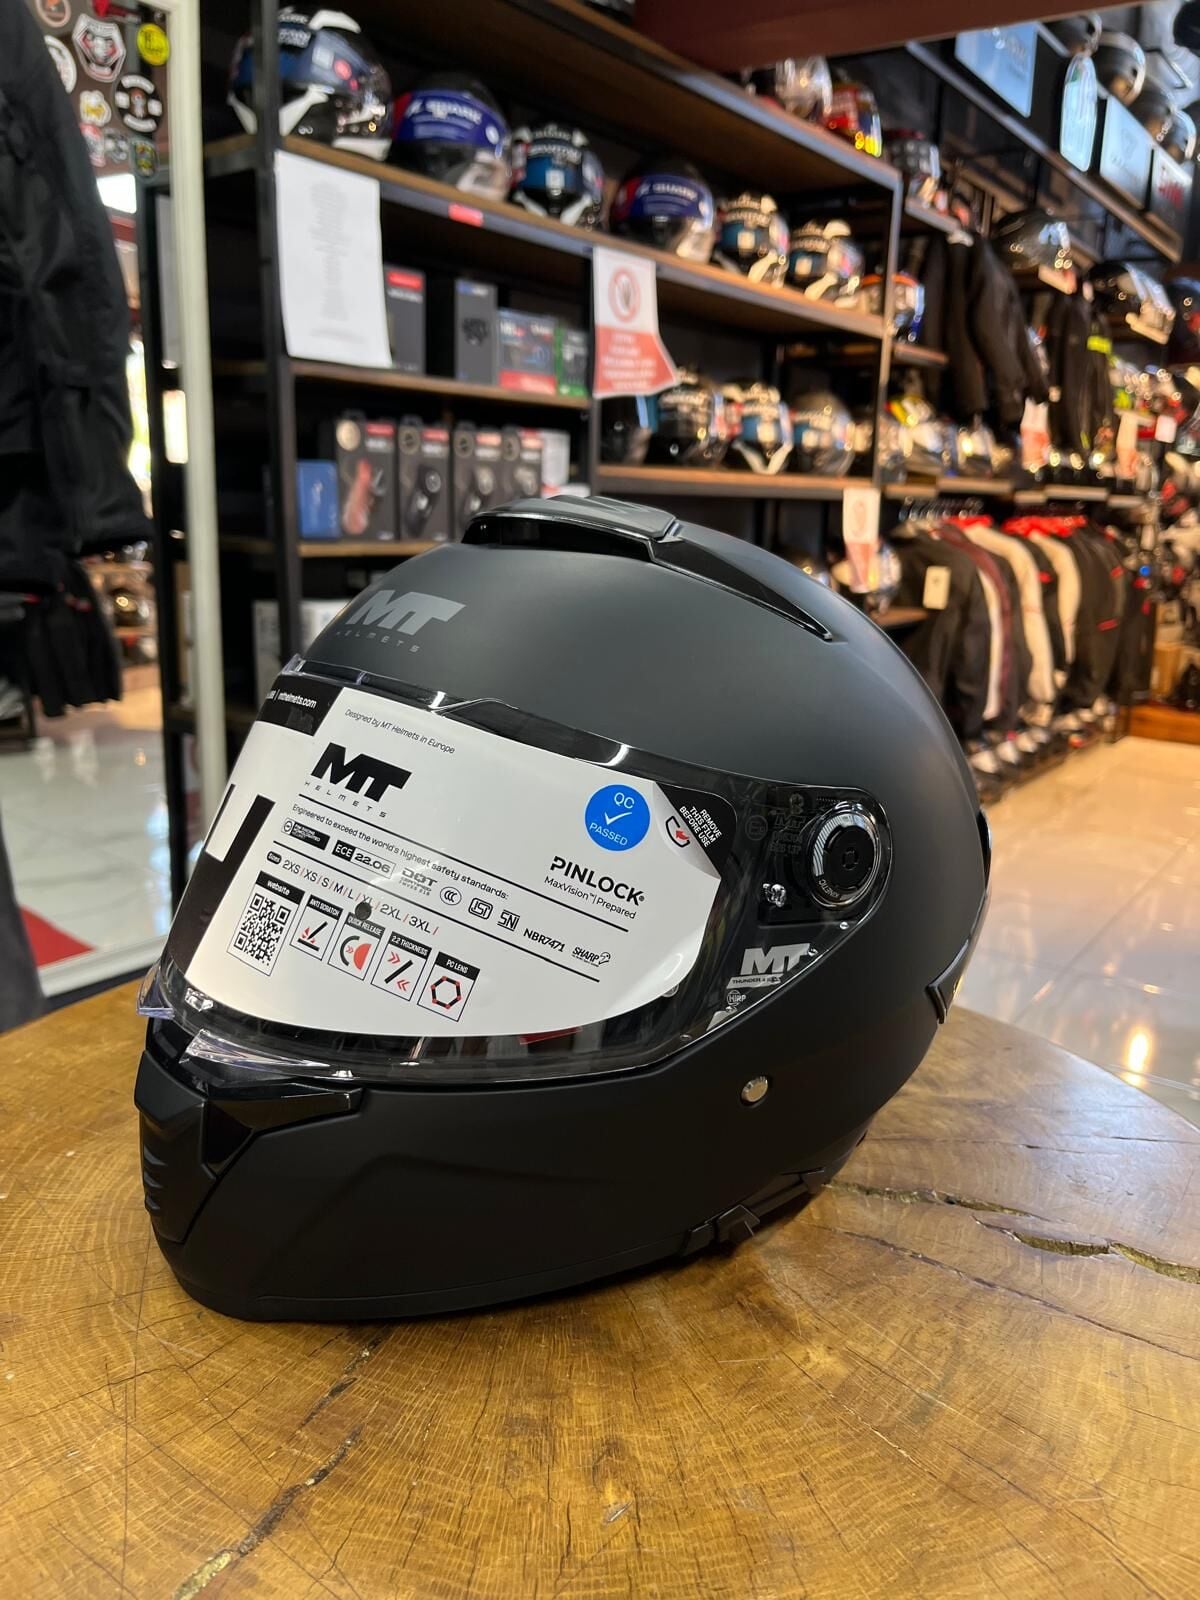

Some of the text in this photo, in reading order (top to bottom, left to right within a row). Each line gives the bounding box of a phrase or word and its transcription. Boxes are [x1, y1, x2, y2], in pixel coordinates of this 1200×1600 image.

[345, 589, 467, 636] MT
[345, 709, 456, 754] Designed by MT Helmets in Europe
[310, 742, 412, 802] MT
[304, 781, 388, 818] HELMETS
[614, 792, 635, 809] QC
[589, 822, 628, 847] PASSED
[680, 805, 711, 848] BEFORE USE
[690, 806, 717, 843] THIS FILM
[699, 808, 723, 838] REMOVE
[292, 803, 325, 823] Engineered
[325, 817, 333, 827] to
[333, 822, 359, 837] exceed
[358, 831, 371, 842] the
[399, 849, 431, 868] highest
[431, 863, 461, 881] safety
[460, 874, 509, 900] standards:
[335, 844, 391, 874] ECE 22.06
[267, 880, 290, 896] website
[402, 867, 438, 887] DOT
[309, 898, 340, 917] ANTI SCRATCH
[596, 897, 637, 919] Prepared
[361, 920, 383, 936] RELEASE
[498, 910, 520, 931] SNI
[400, 939, 429, 957] THICKNESS
[523, 928, 565, 952] NBR7471
[446, 959, 469, 974] PC LENS
[572, 946, 600, 963] SHARP
[740, 943, 810, 975] MT
